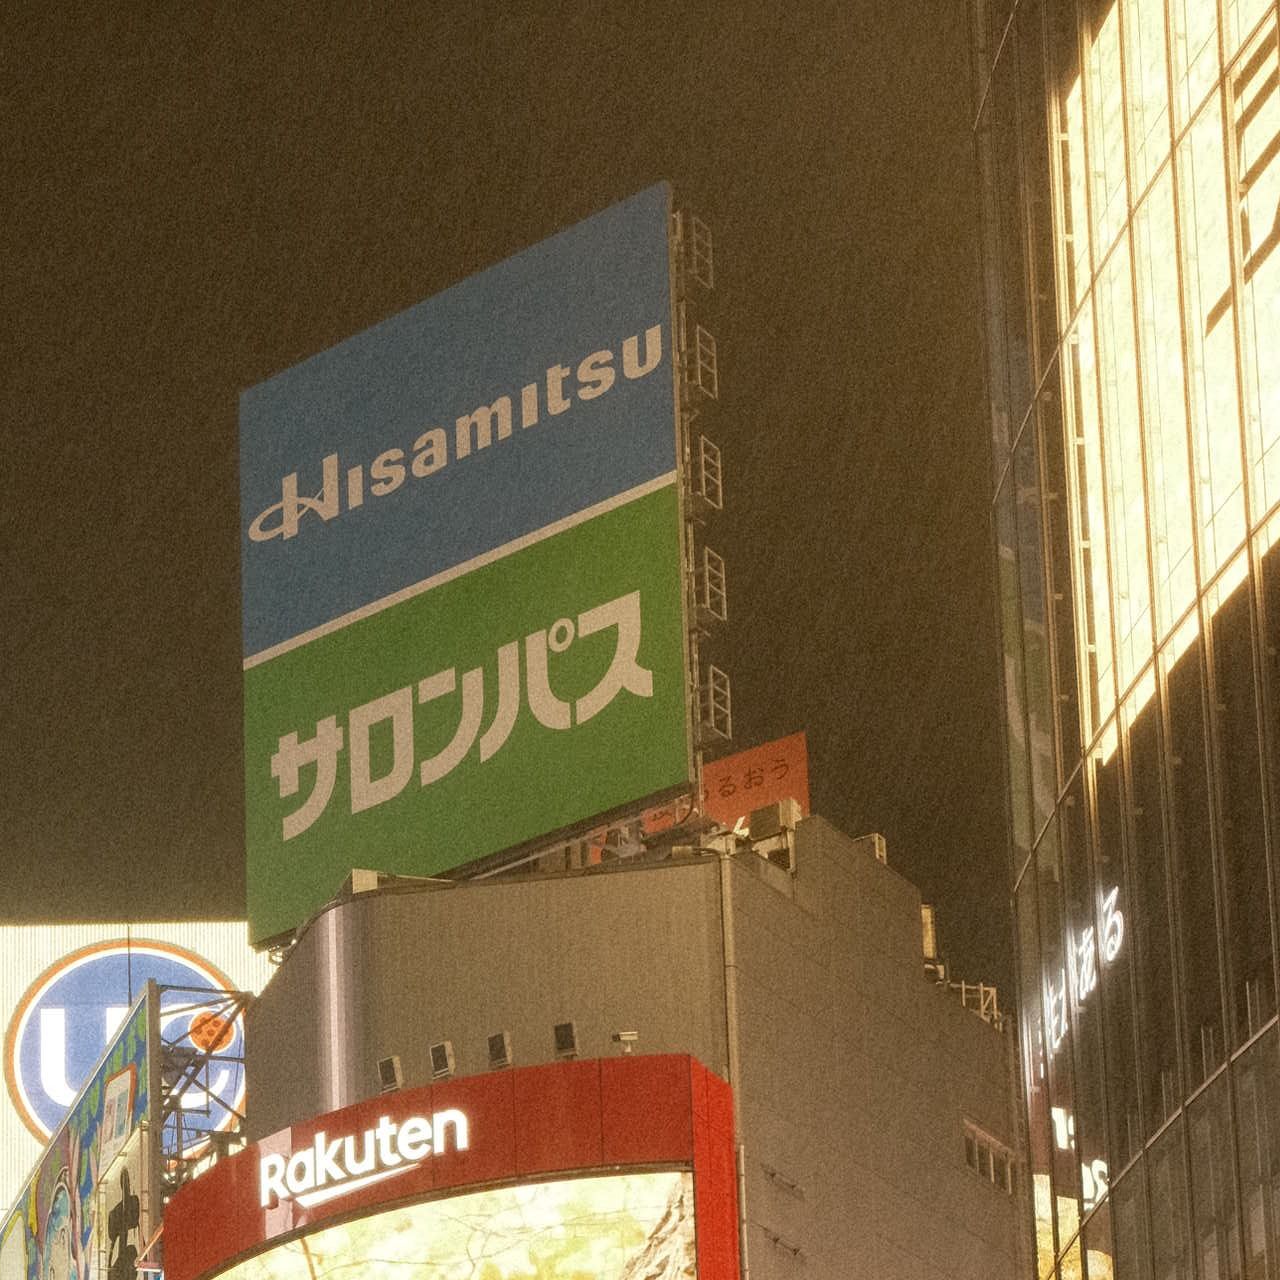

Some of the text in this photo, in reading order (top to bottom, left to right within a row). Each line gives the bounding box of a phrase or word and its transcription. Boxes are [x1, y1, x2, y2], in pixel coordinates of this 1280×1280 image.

[248, 324, 663, 544] Hisamitsu
[271, 590, 654, 842] サロンパス
[260, 1108, 468, 1208] Rakuten
